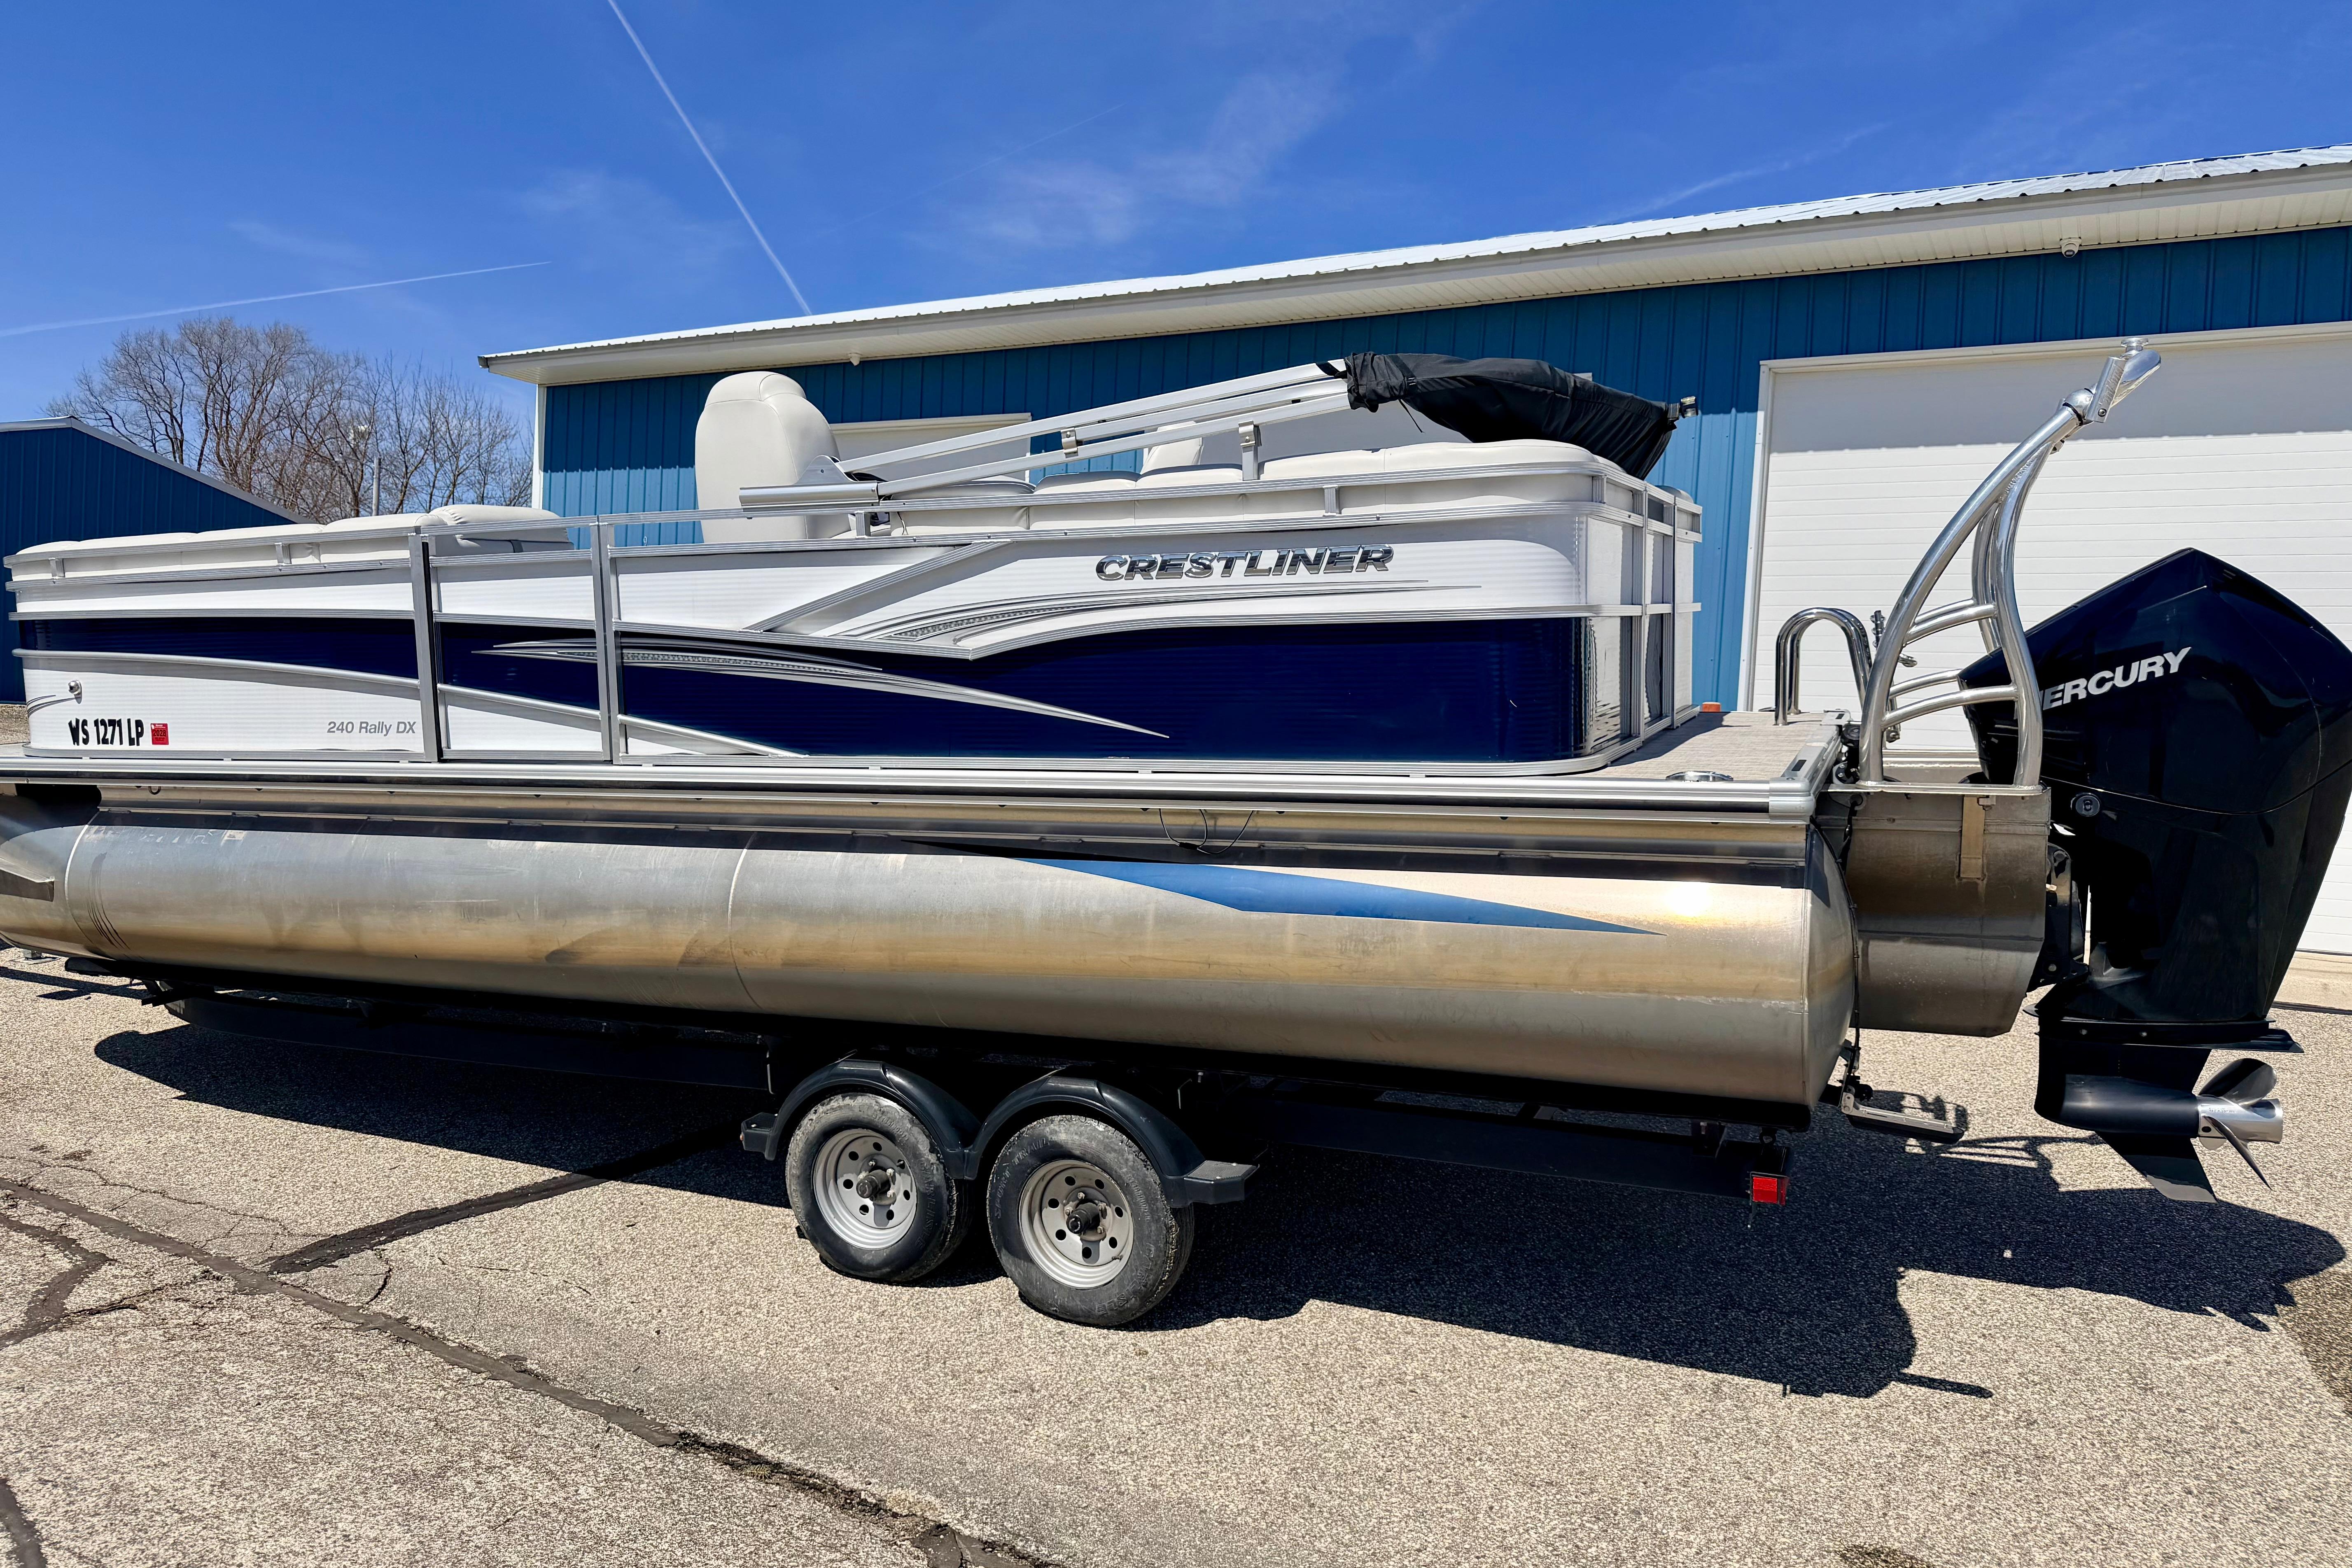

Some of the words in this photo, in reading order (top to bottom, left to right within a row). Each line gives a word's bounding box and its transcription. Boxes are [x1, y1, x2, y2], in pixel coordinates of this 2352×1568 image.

[1096, 544, 1394, 581] CRESTLINER
[68, 717, 89, 746] WS
[94, 718, 123, 745] 1271
[127, 718, 144, 746] LP
[327, 721, 354, 733] 240
[359, 721, 392, 736] Rally
[396, 721, 416, 734] DX
[915, 1157, 936, 1249] CARLISLE
[994, 1166, 1012, 1219] SPORT
[1095, 1242, 1156, 1315] CARLISLE
